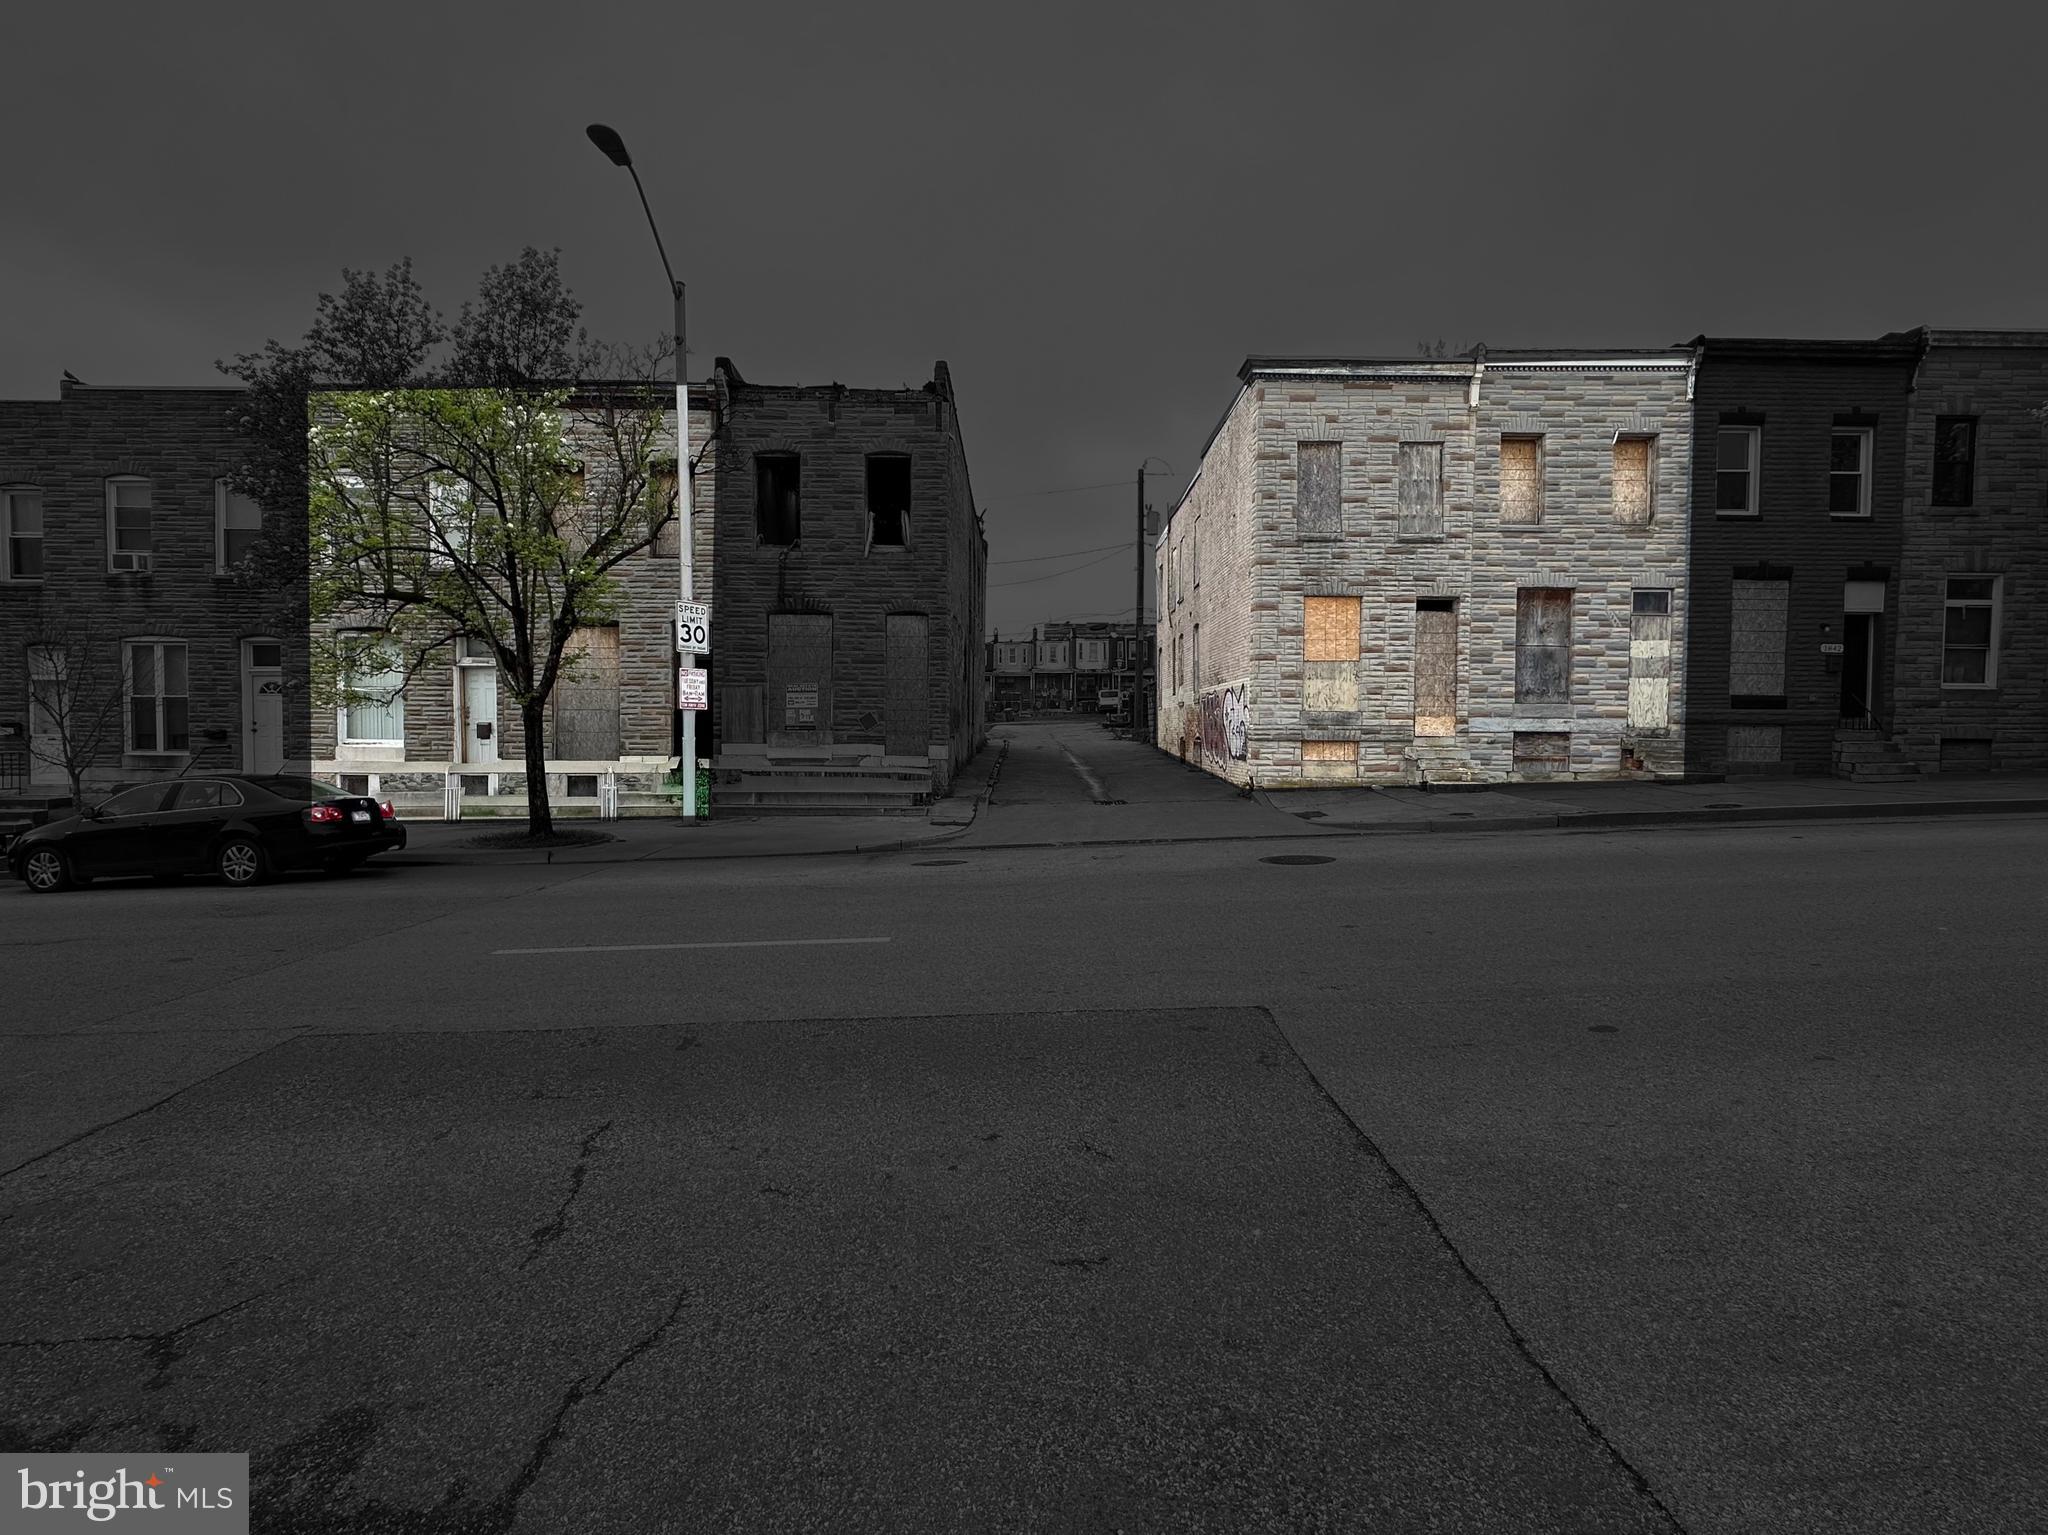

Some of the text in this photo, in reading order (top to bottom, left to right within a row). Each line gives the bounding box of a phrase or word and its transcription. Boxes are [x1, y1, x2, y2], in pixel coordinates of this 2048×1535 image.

[678, 604, 706, 616] SPEED
[682, 615, 703, 625] LIMIT
[680, 624, 706, 644] 30
